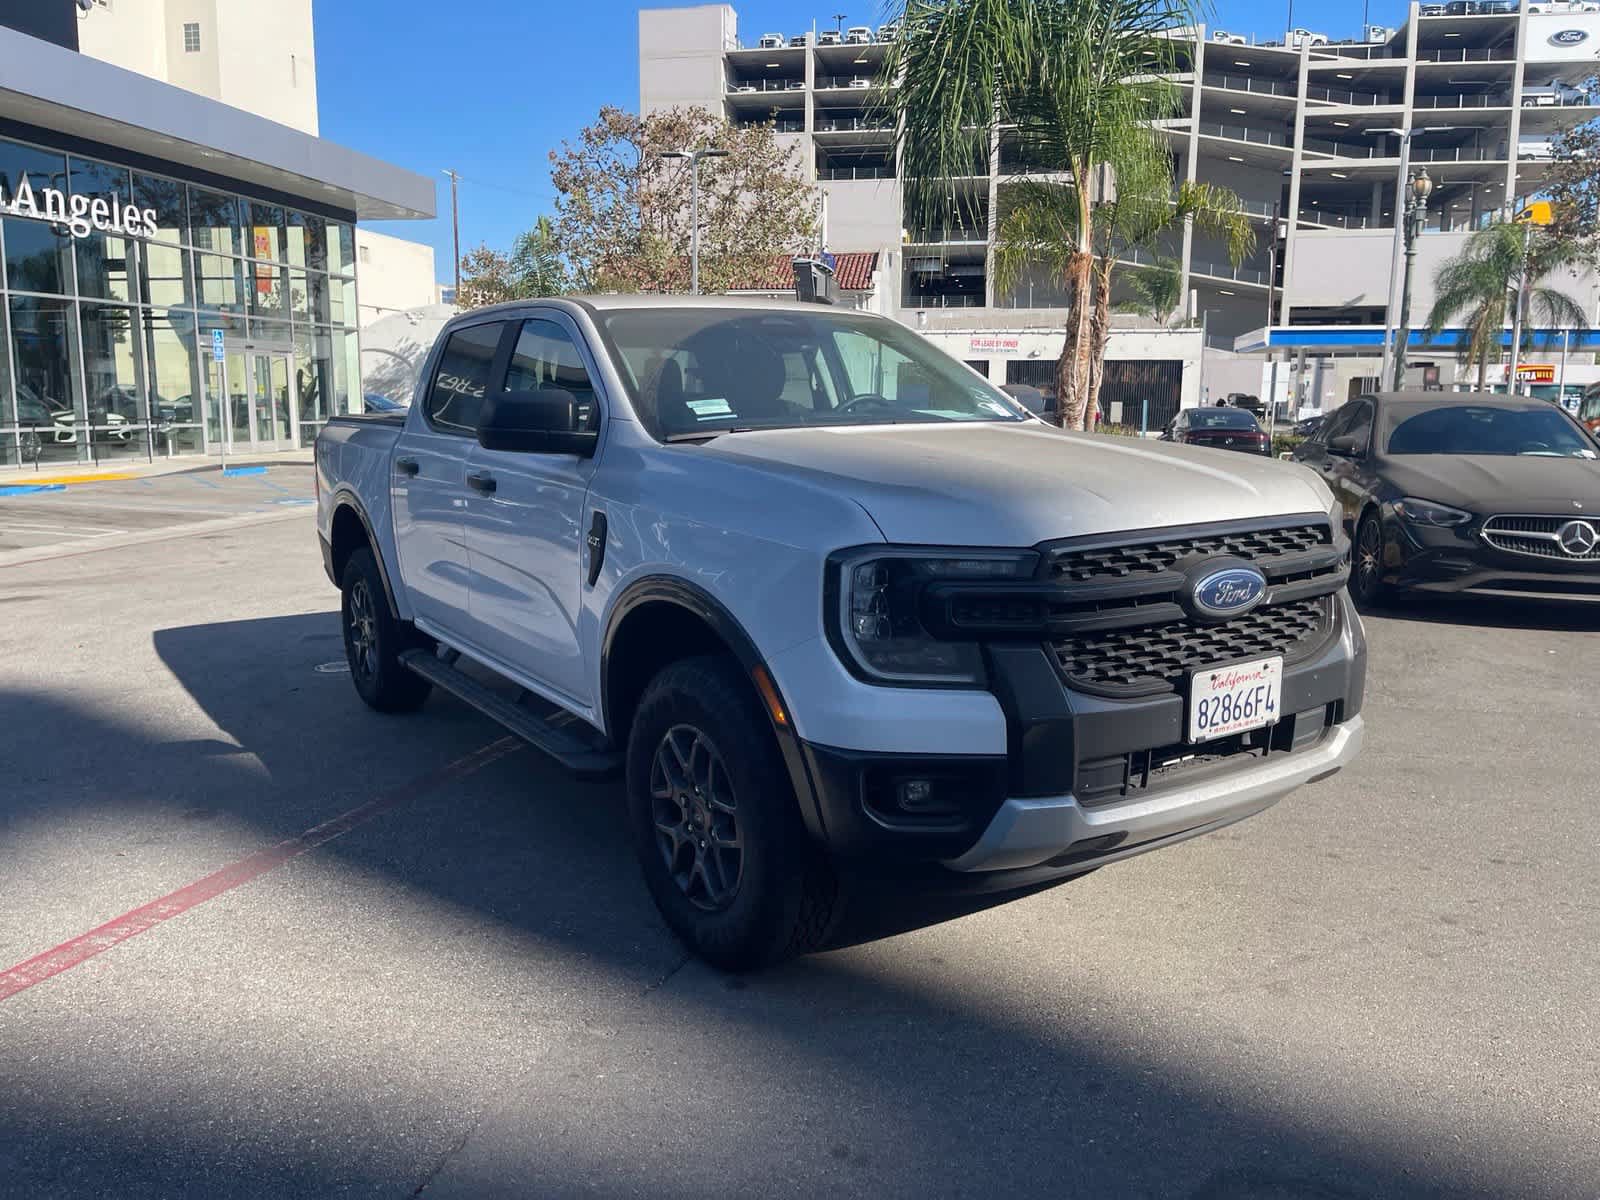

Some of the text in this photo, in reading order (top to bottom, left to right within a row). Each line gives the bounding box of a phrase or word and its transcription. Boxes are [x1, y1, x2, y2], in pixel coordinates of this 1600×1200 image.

[1560, 31, 1583, 42] Ford
[10, 170, 159, 239] Angeles
[982, 339, 995, 347] LEASE
[995, 339, 1002, 347] BY
[1003, 339, 1018, 347] OWNER
[1214, 579, 1252, 605] Ford
[1210, 671, 1265, 691] California
[1198, 684, 1275, 730] 82866F4
